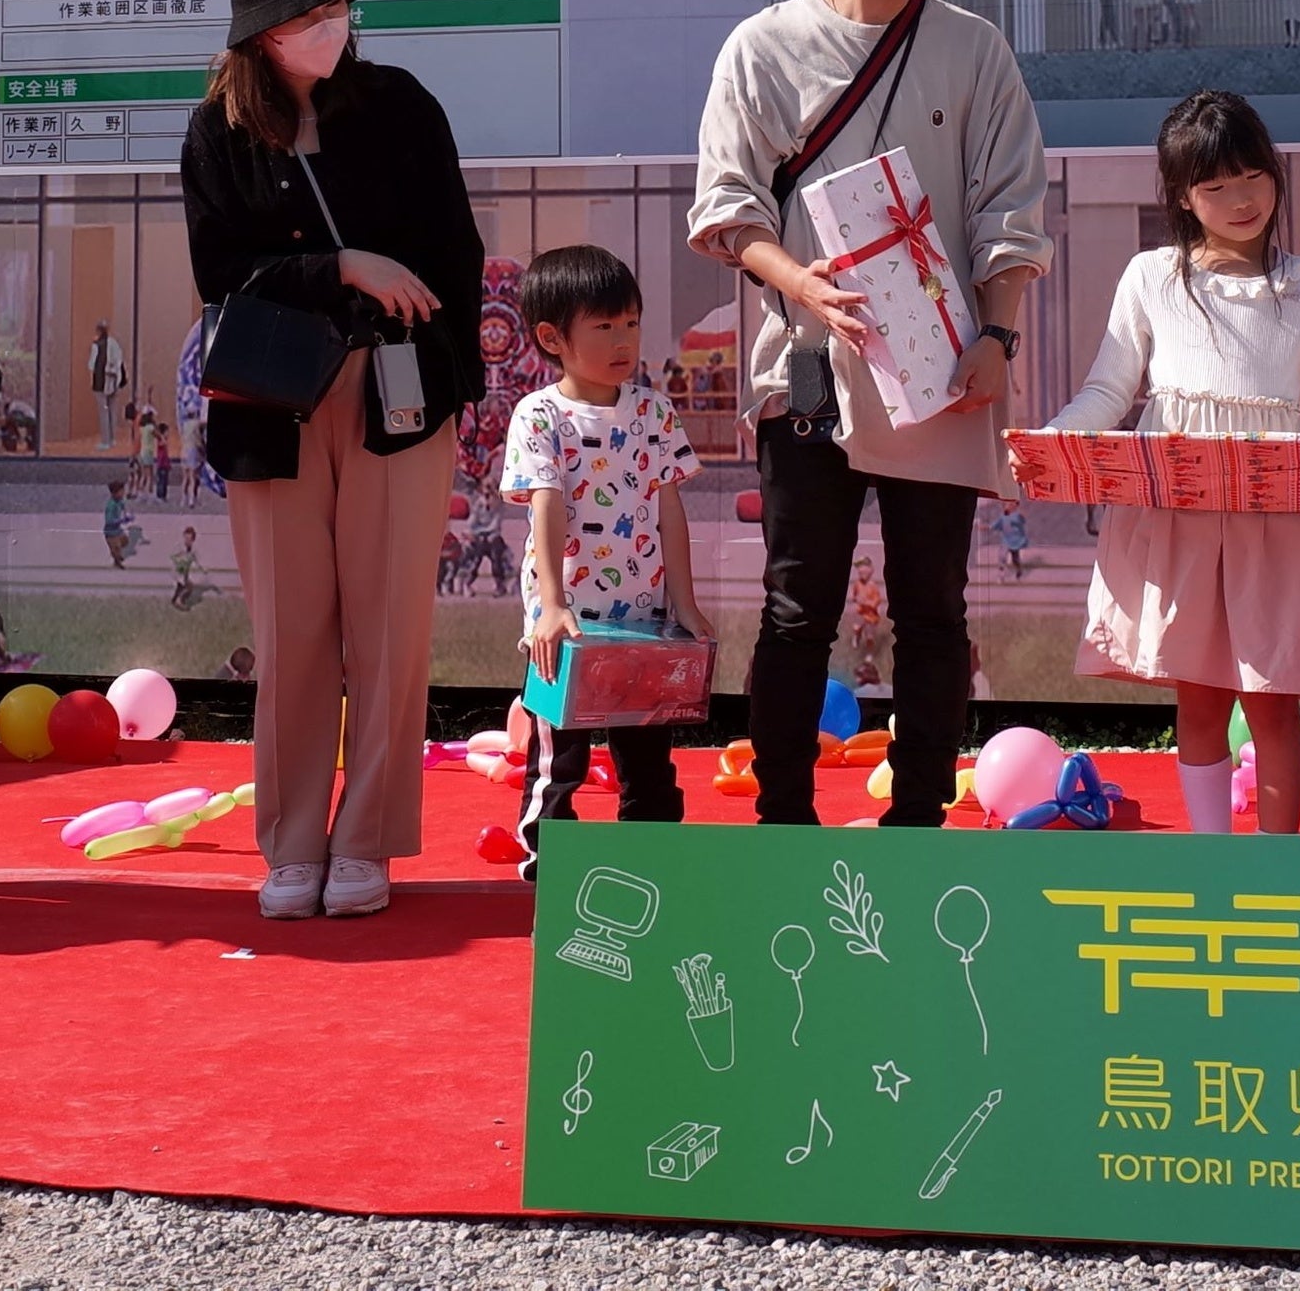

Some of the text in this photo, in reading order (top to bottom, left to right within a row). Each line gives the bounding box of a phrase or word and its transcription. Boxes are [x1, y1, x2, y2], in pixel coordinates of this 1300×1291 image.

[8, 78, 78, 99] 安全当番
[5, 116, 58, 134] 作業所
[5, 141, 58, 160] リーダー会
[1098, 1153, 1233, 1186] TOTTORI
